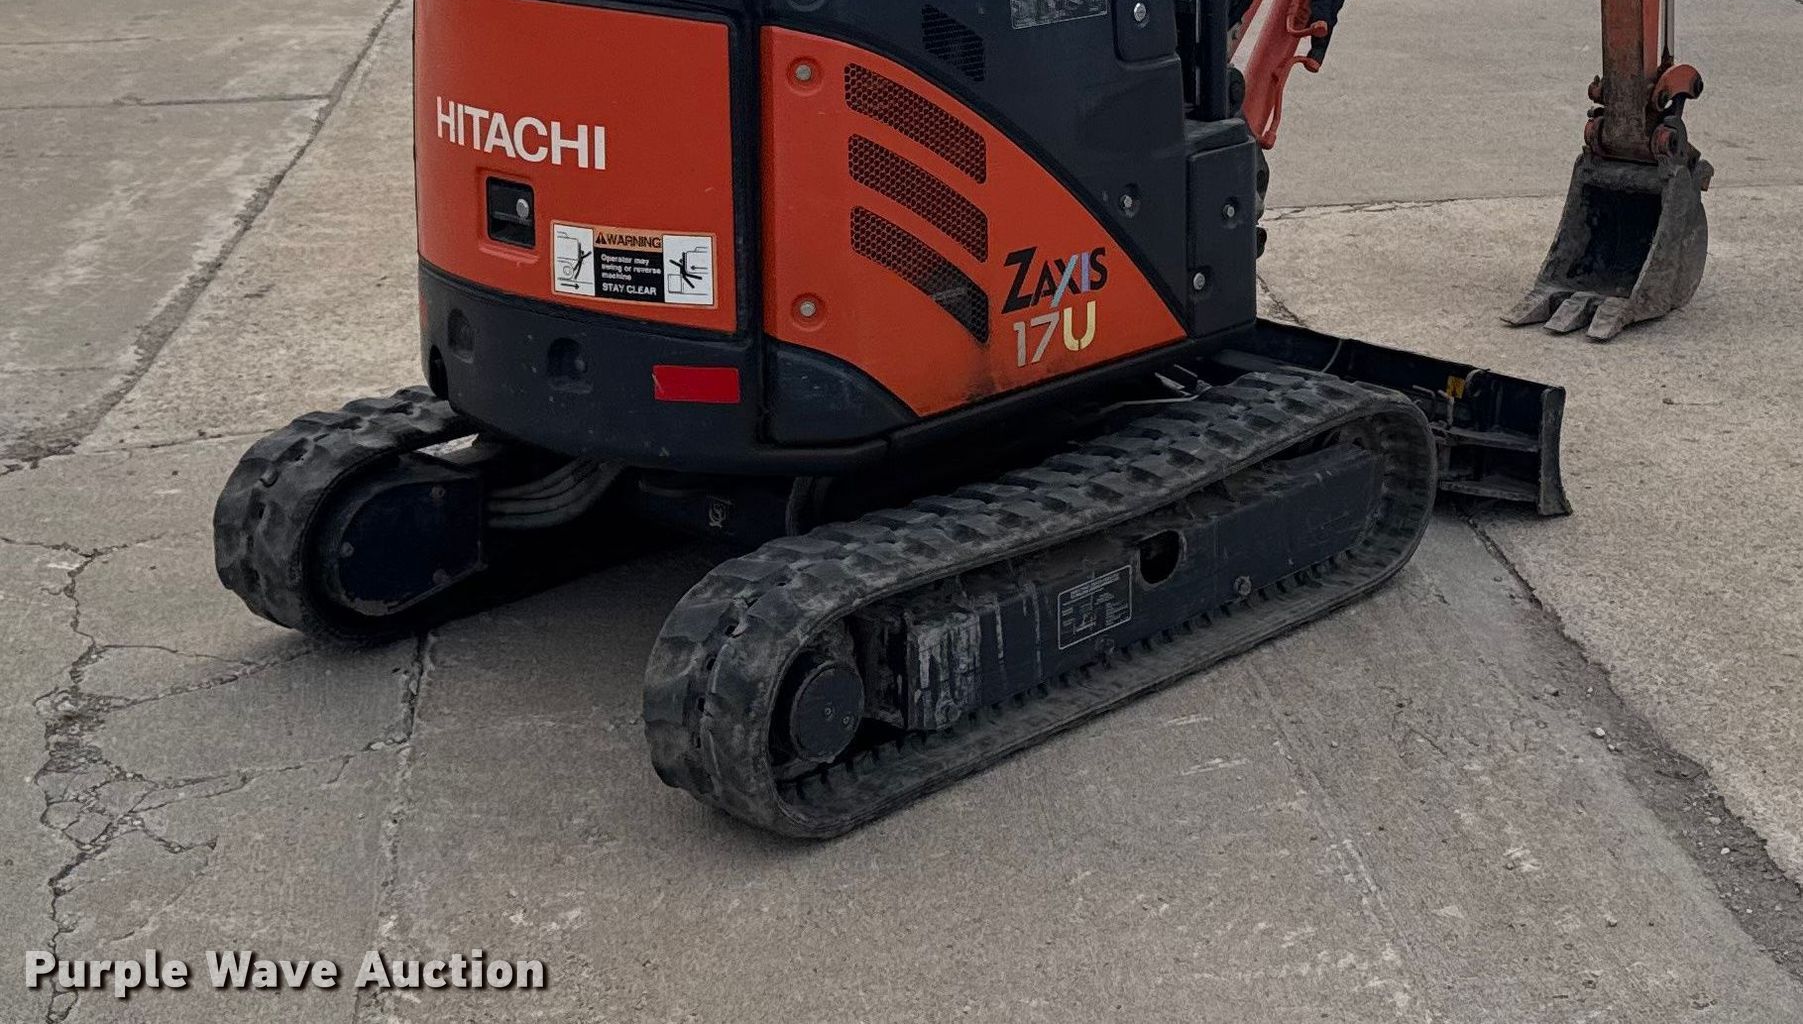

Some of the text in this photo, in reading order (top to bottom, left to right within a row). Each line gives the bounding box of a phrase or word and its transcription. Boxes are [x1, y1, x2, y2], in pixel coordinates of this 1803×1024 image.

[437, 96, 606, 170] HITACHI
[606, 233, 661, 248] WARNING
[600, 253, 650, 266] Operator may
[633, 267, 662, 275] reverse
[1001, 246, 1108, 314] ZAXIS
[602, 282, 657, 296] STAY CLEAR
